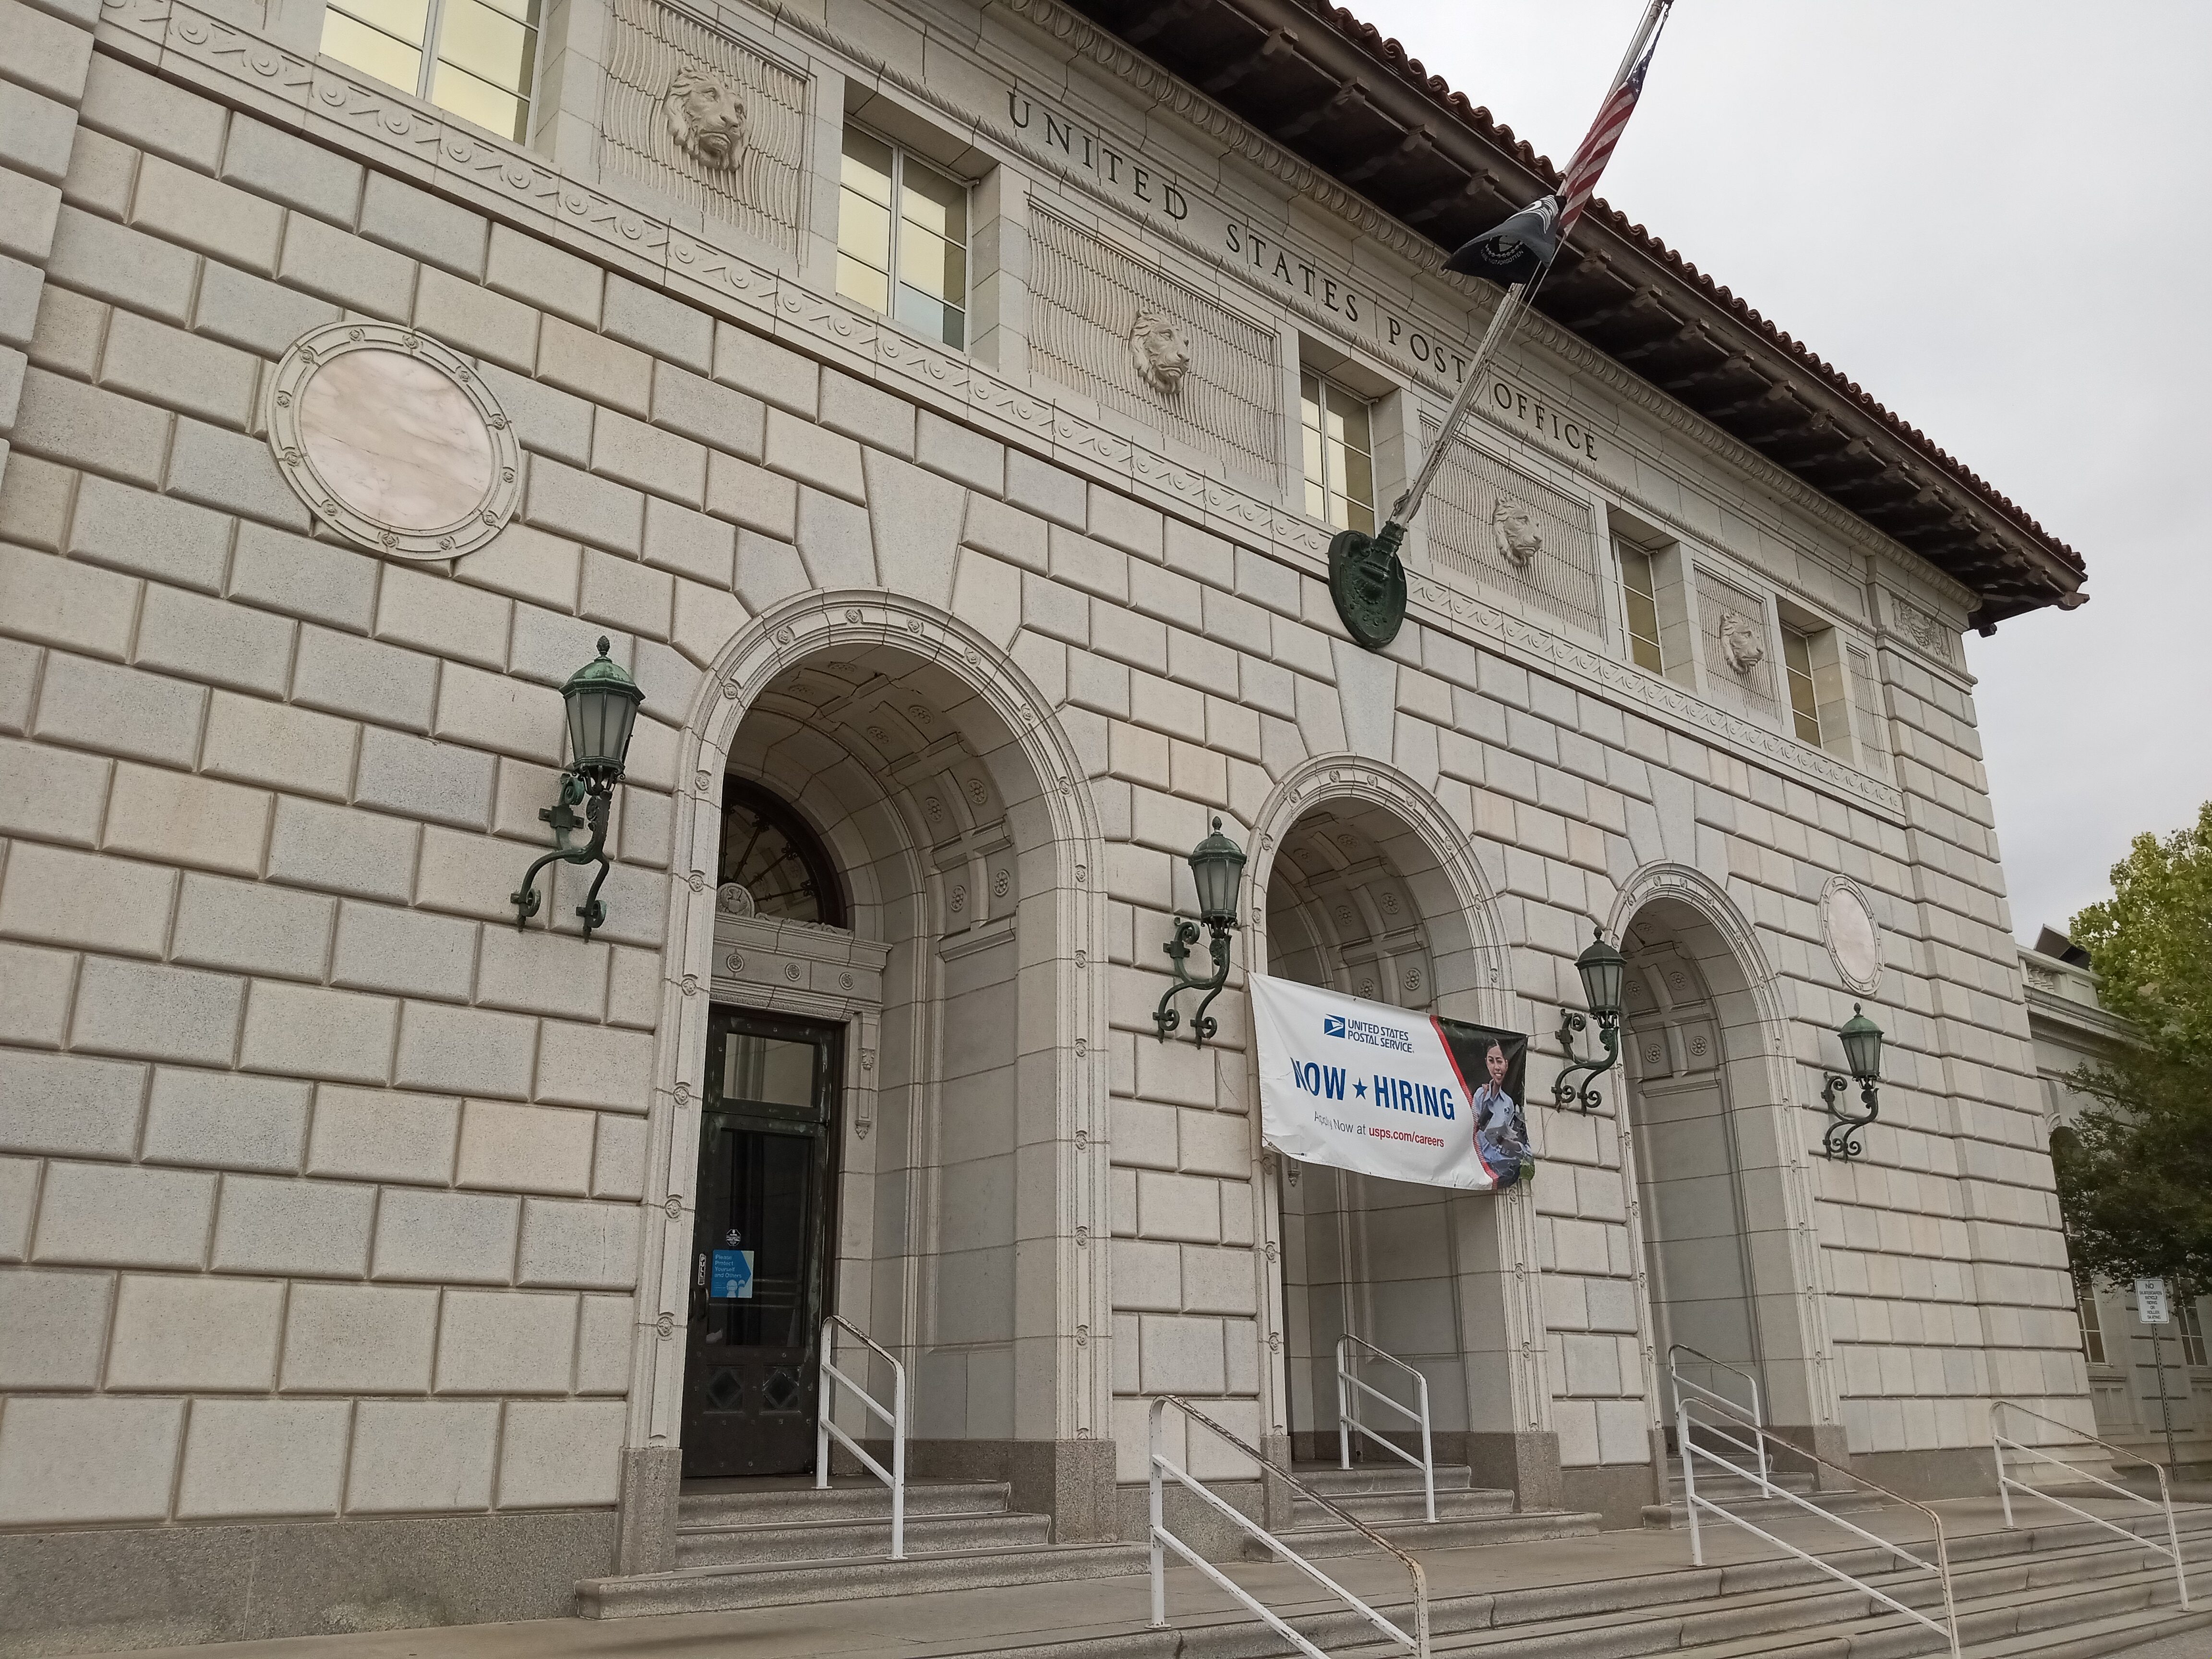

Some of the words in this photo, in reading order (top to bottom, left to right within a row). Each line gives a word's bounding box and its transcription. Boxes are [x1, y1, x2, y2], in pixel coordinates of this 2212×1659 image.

[1007, 91, 1188, 221] UNITED
[1227, 224, 1359, 323] STATES
[1386, 316, 1466, 384] POST
[1493, 383, 1598, 461] OFFICE
[1348, 1019, 1379, 1034] UNITED
[1381, 1027, 1408, 1041] STATES
[1348, 1030, 1379, 1046] POSTAL
[1290, 1057, 1346, 1101] NOW
[1373, 1074, 1455, 1120] HIRING
[1333, 1118, 1354, 1133] Now
[1357, 1124, 1366, 1135] at
[1369, 1127, 1444, 1148] usps.com/careers
